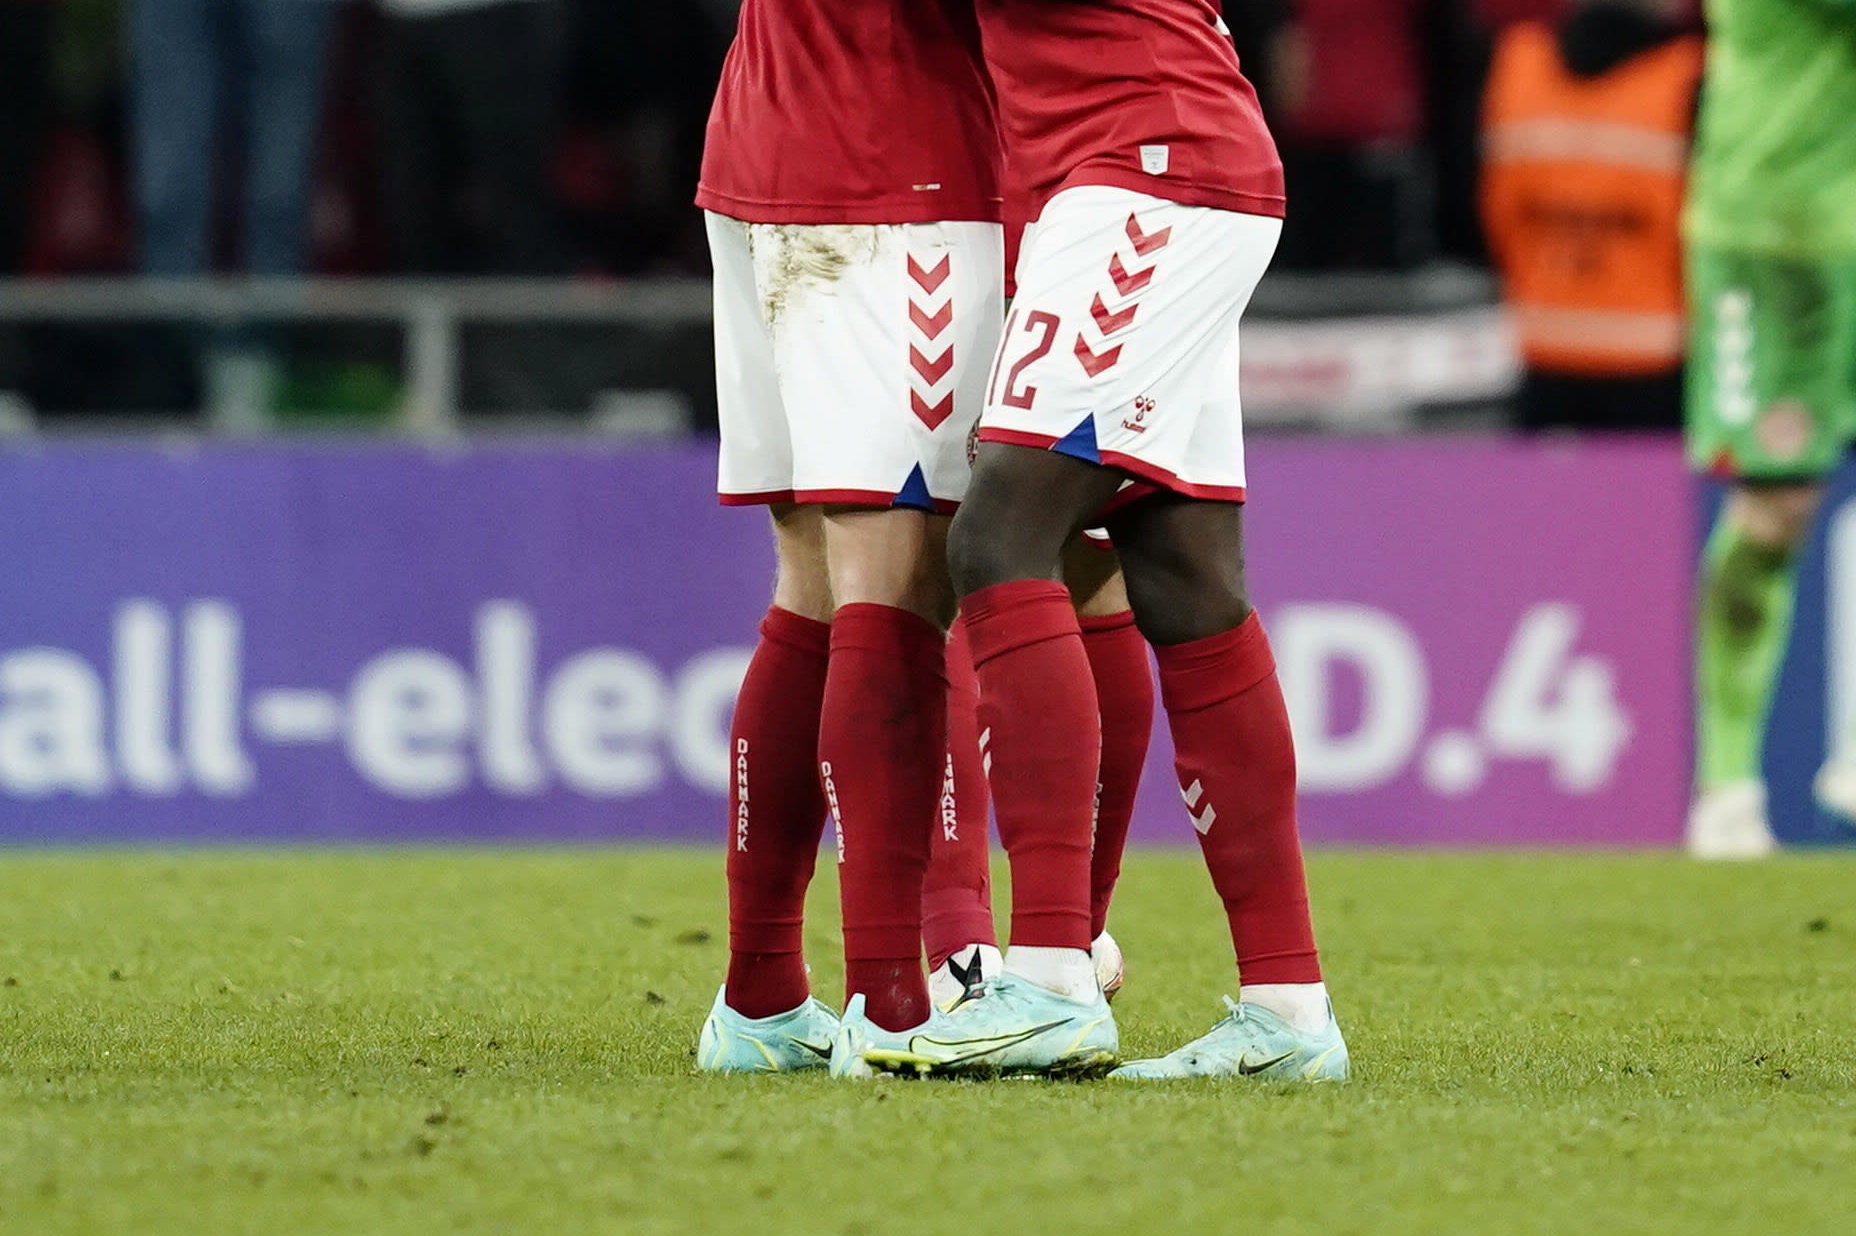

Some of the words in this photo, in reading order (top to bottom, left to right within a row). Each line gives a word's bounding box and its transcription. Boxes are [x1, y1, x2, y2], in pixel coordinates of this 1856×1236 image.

[988, 309, 1060, 411] 12
[737, 737, 749, 853] DANMARK
[821, 761, 846, 864] DANMARK
